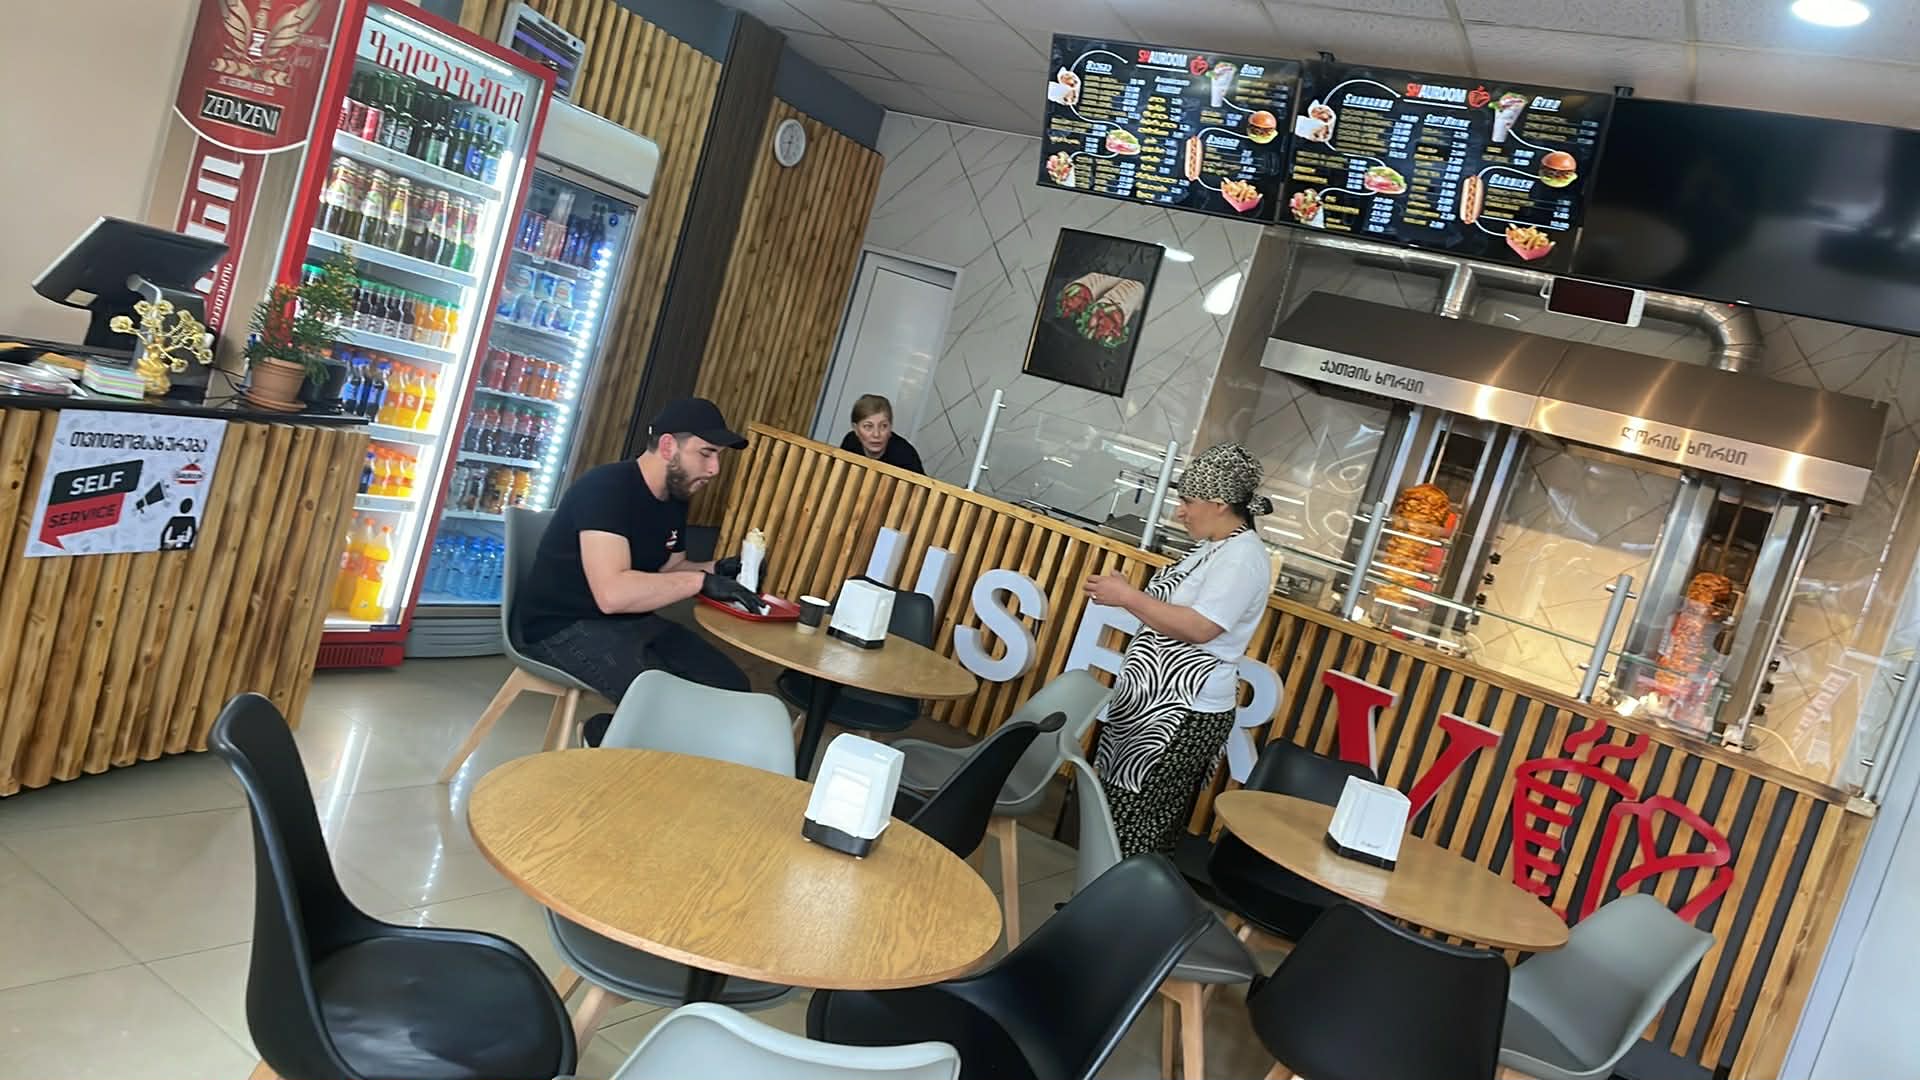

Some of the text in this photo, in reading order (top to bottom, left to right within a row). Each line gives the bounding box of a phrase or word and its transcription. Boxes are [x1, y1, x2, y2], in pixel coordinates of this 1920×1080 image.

[203, 95, 279, 132] ZEDAZENI
[1319, 359, 1425, 395] ქათმის ხორცი
[1621, 426, 1748, 466] ღორის ხორცი
[69, 471, 125, 496] SELF
[47, 503, 117, 529] SERVICE
